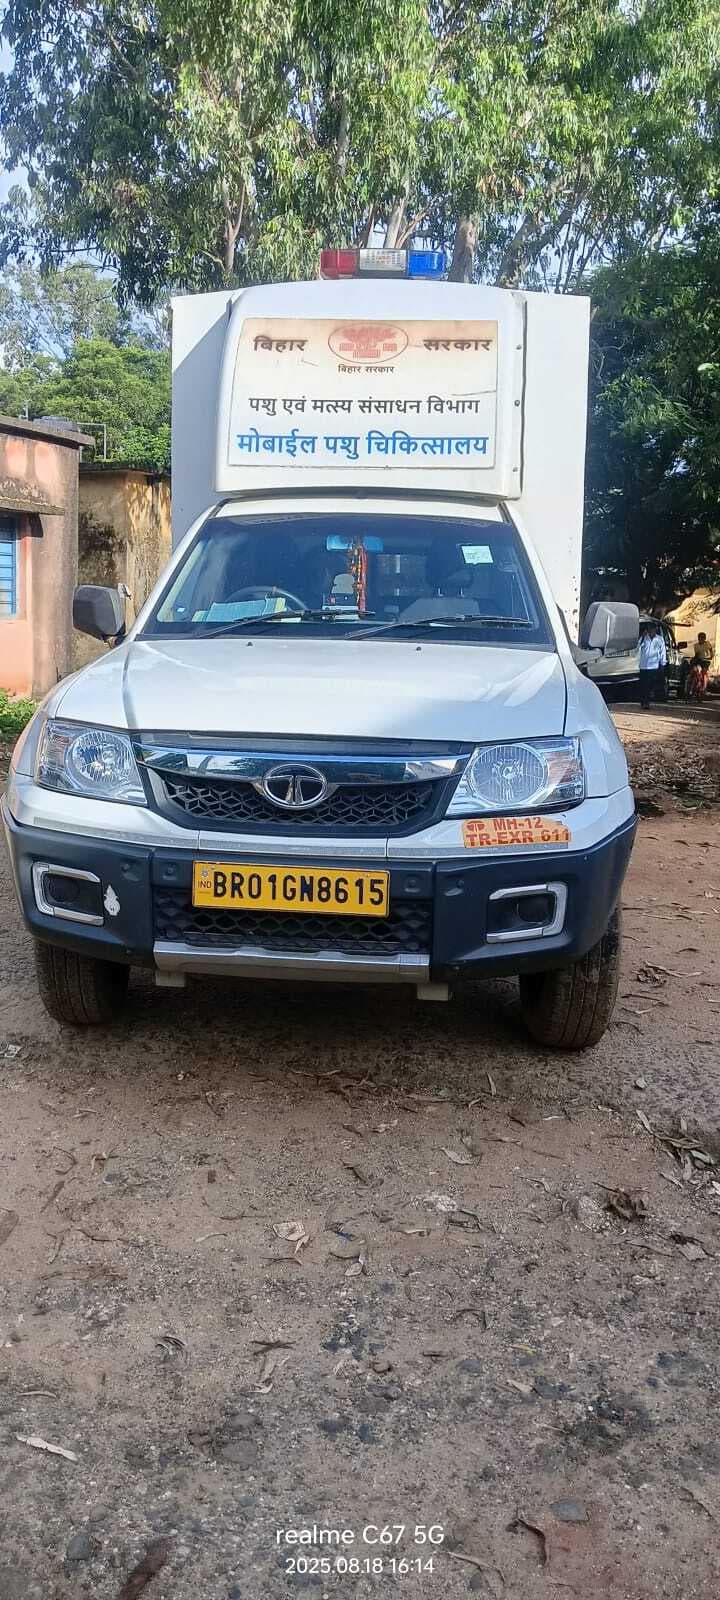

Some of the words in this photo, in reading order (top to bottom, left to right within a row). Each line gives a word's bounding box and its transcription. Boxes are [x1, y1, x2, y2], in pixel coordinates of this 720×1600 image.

[253, 335, 308, 351] बिहार
[423, 338, 493, 351] सरकार
[337, 363, 362, 374] बिहार
[365, 366, 395, 374] सरकार
[249, 398, 277, 416] पशु
[282, 395, 306, 414] एवं
[311, 398, 352, 414] मत्स्य
[358, 394, 420, 414] संसाधन
[427, 396, 480, 414] विभाग
[236, 428, 318, 456] मोबाईल
[324, 436, 360, 459] पशु
[366, 430, 489, 455] चिकित्सालय
[493, 816, 543, 831] MH-12
[466, 830, 534, 847] TR-EXR
[198, 879, 212, 889] IND
[213, 871, 384, 906] BR01GN8615
